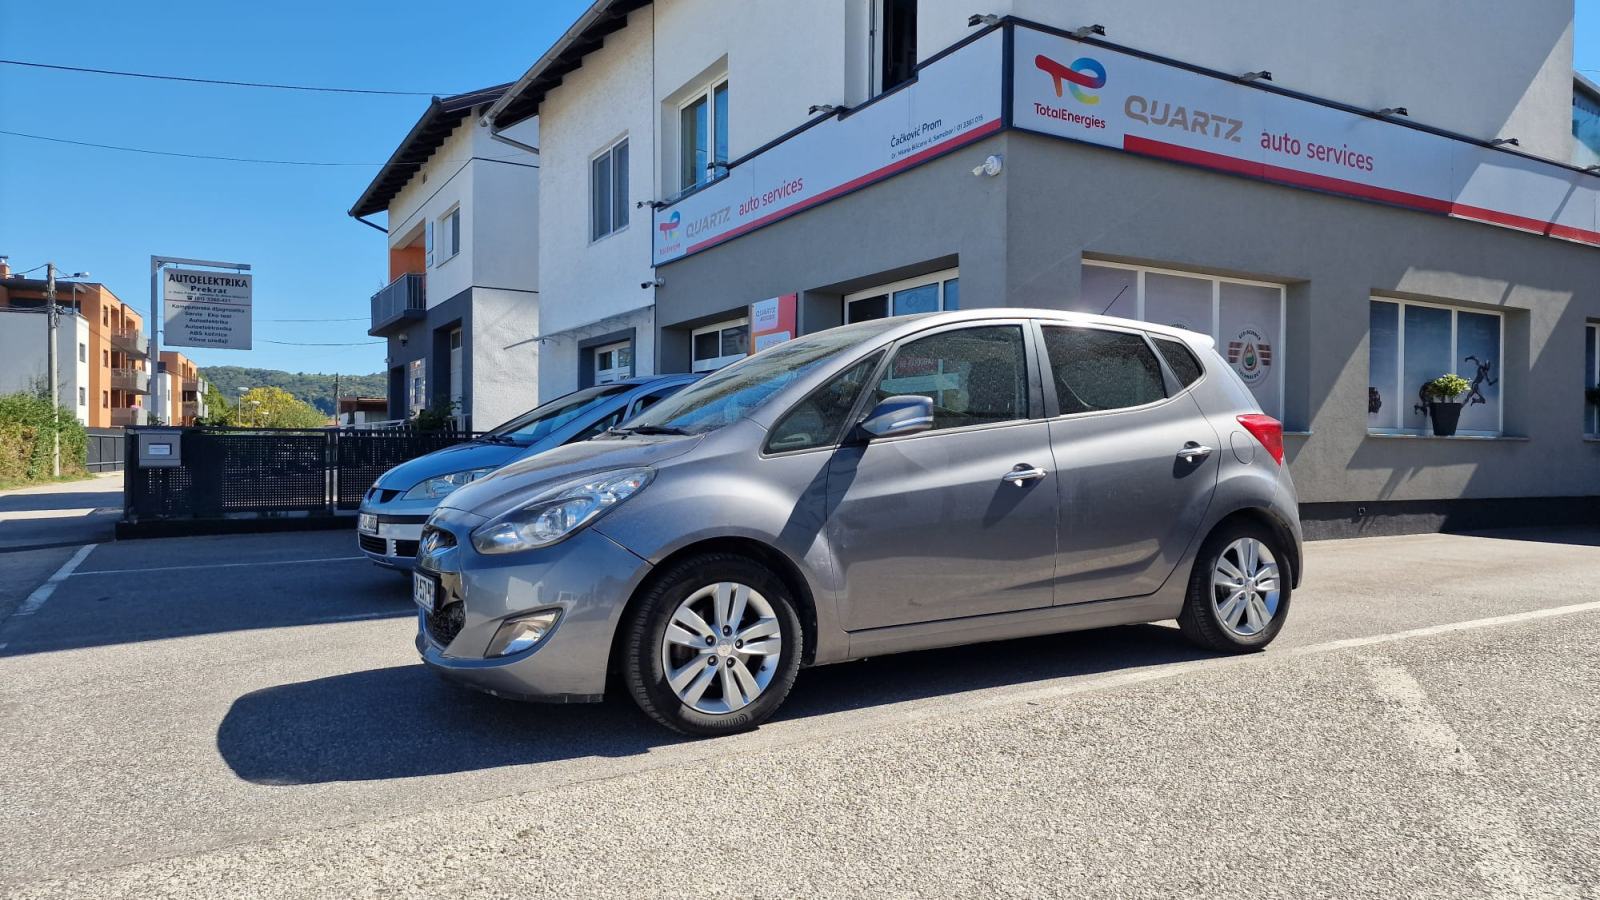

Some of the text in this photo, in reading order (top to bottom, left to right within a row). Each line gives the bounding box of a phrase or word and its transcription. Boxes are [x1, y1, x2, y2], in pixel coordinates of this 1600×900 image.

[922, 119, 942, 134] Prom
[1034, 102, 1106, 129] TotalEnergies
[1124, 95, 1374, 171] QUARTZ auto services
[686, 177, 803, 238] QUARTZ auto services
[168, 273, 248, 288] AUTOELEKTRIKA
